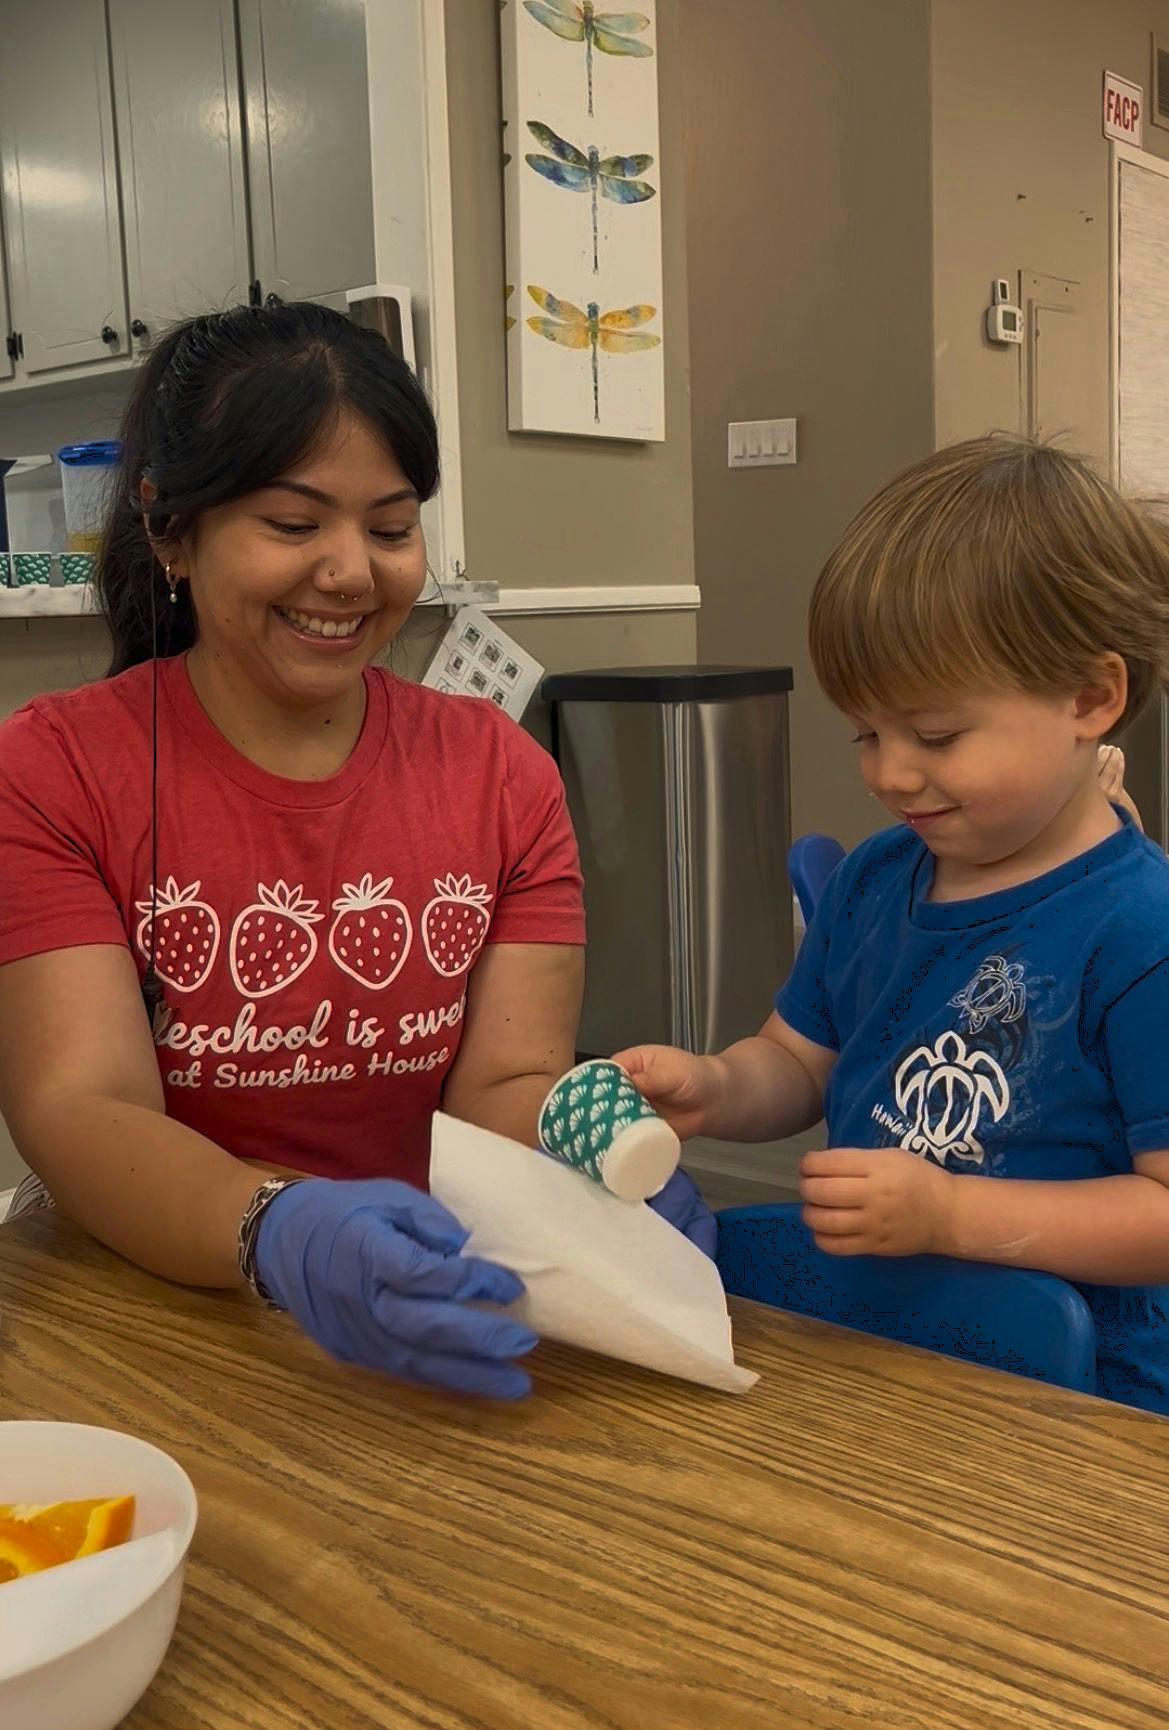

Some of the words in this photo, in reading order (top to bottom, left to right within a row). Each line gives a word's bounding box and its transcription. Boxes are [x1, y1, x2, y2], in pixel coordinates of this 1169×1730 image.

[1106, 89, 1140, 132] FACP
[346, 1008, 384, 1048] is
[167, 1060, 202, 1088] at
[213, 1054, 357, 1089] Sunshine
[367, 1046, 451, 1076] House
[871, 1103, 912, 1137] Hawaii
